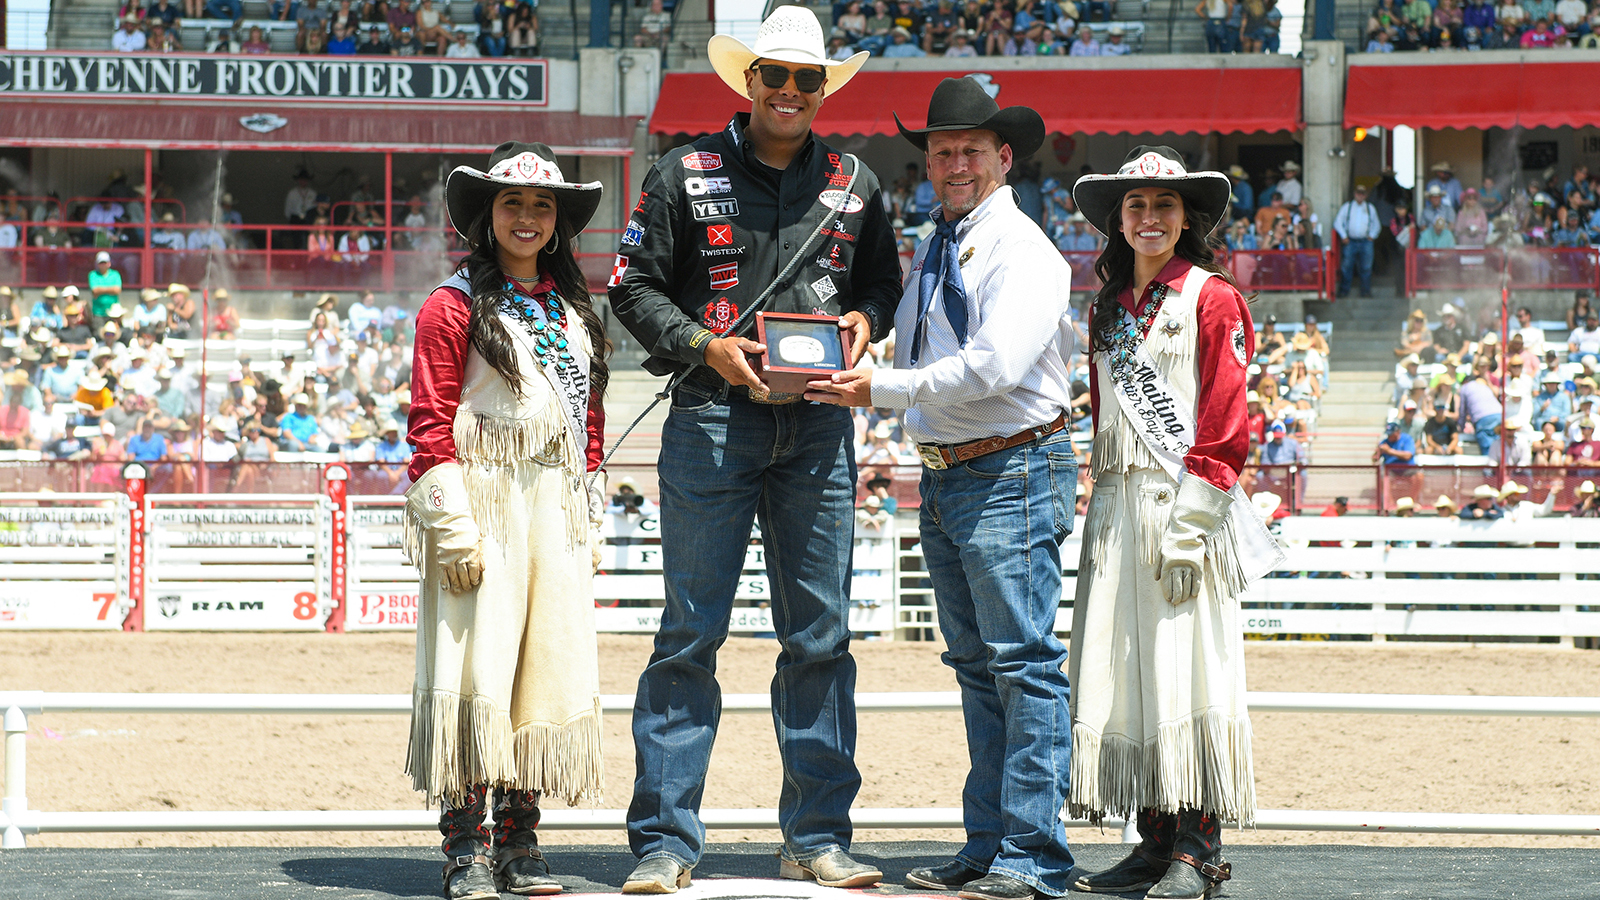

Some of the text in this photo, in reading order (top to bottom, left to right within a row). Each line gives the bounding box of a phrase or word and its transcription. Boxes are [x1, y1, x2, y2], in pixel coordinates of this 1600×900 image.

[215, 60, 415, 97] FRONTIER
[431, 64, 529, 99] DAYS
[694, 200, 735, 217] YETI
[712, 268, 738, 282] MVP
[1133, 361, 1186, 439] Waiting
[92, 592, 117, 621] 7
[192, 601, 264, 611] RAM
[292, 591, 317, 621] 8
